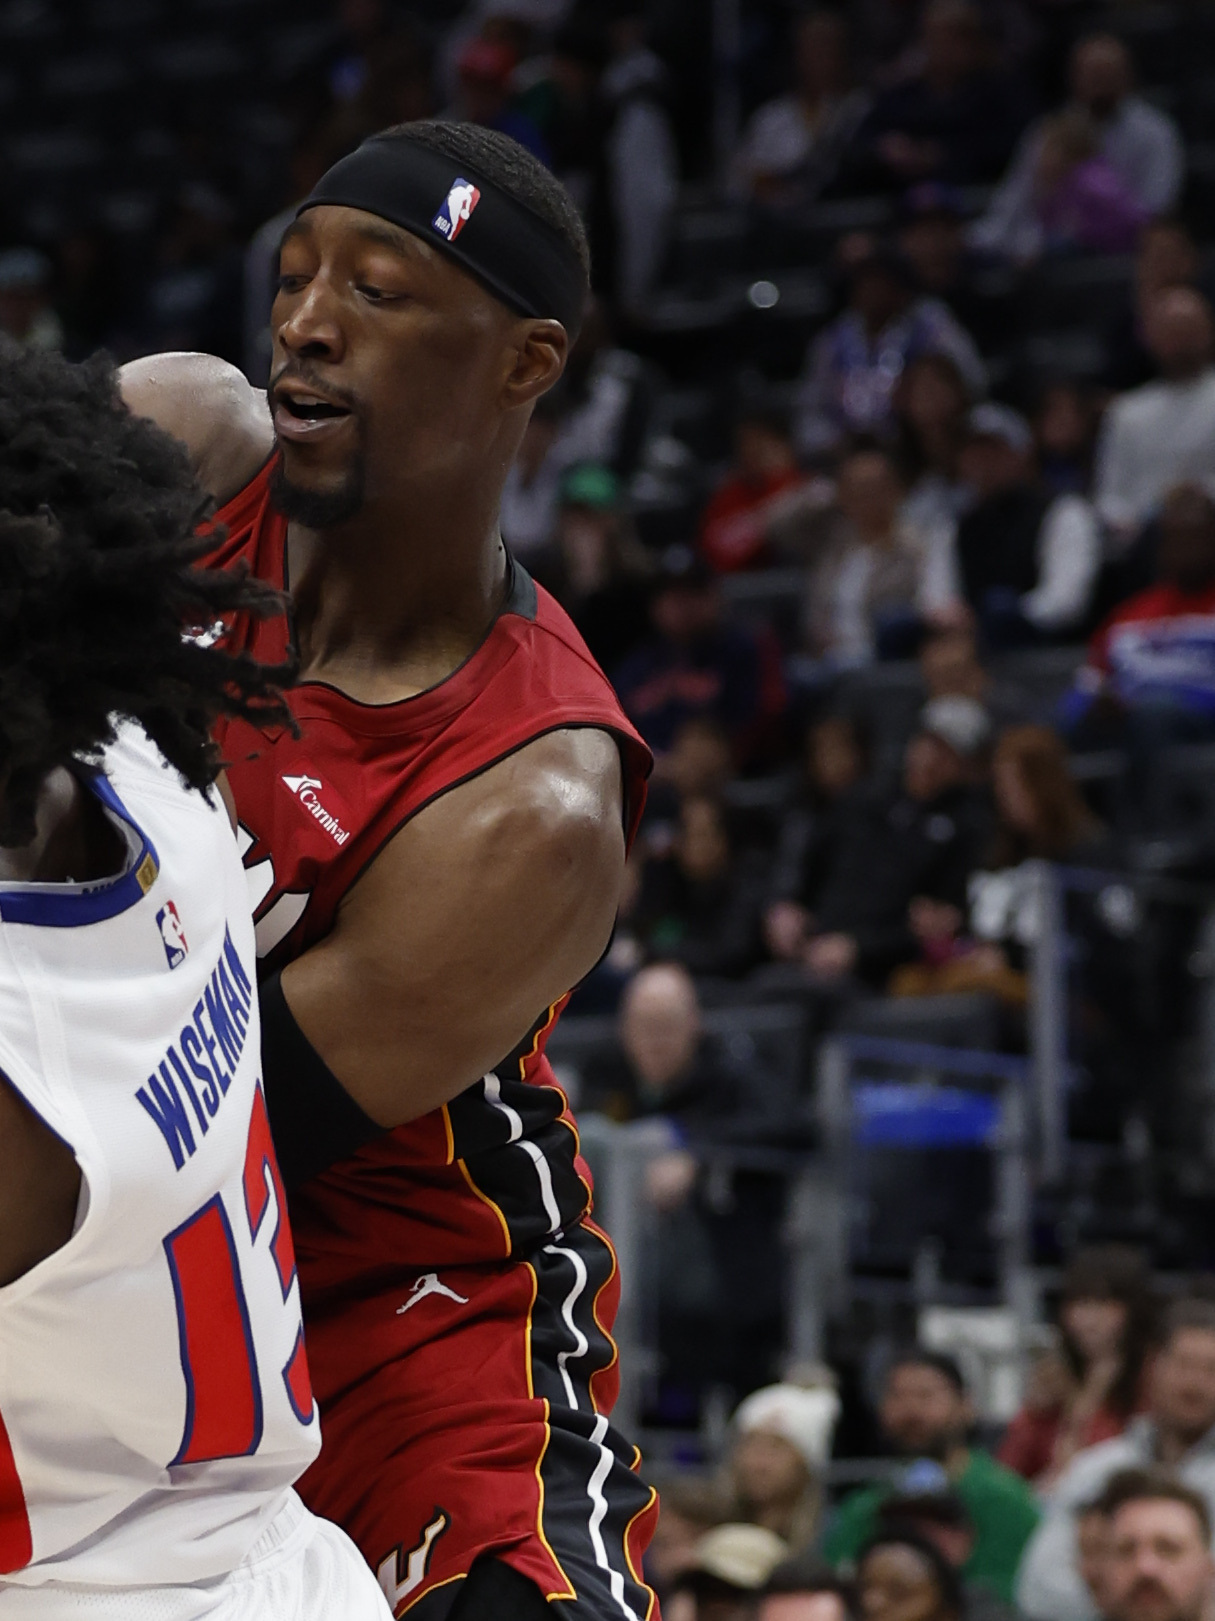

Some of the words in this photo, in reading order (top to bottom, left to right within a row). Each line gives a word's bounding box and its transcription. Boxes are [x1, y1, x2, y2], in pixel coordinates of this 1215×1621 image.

[434, 215, 451, 234] NBA
[299, 789, 350, 846] Carnival
[134, 917, 252, 1173] WISEMAN
